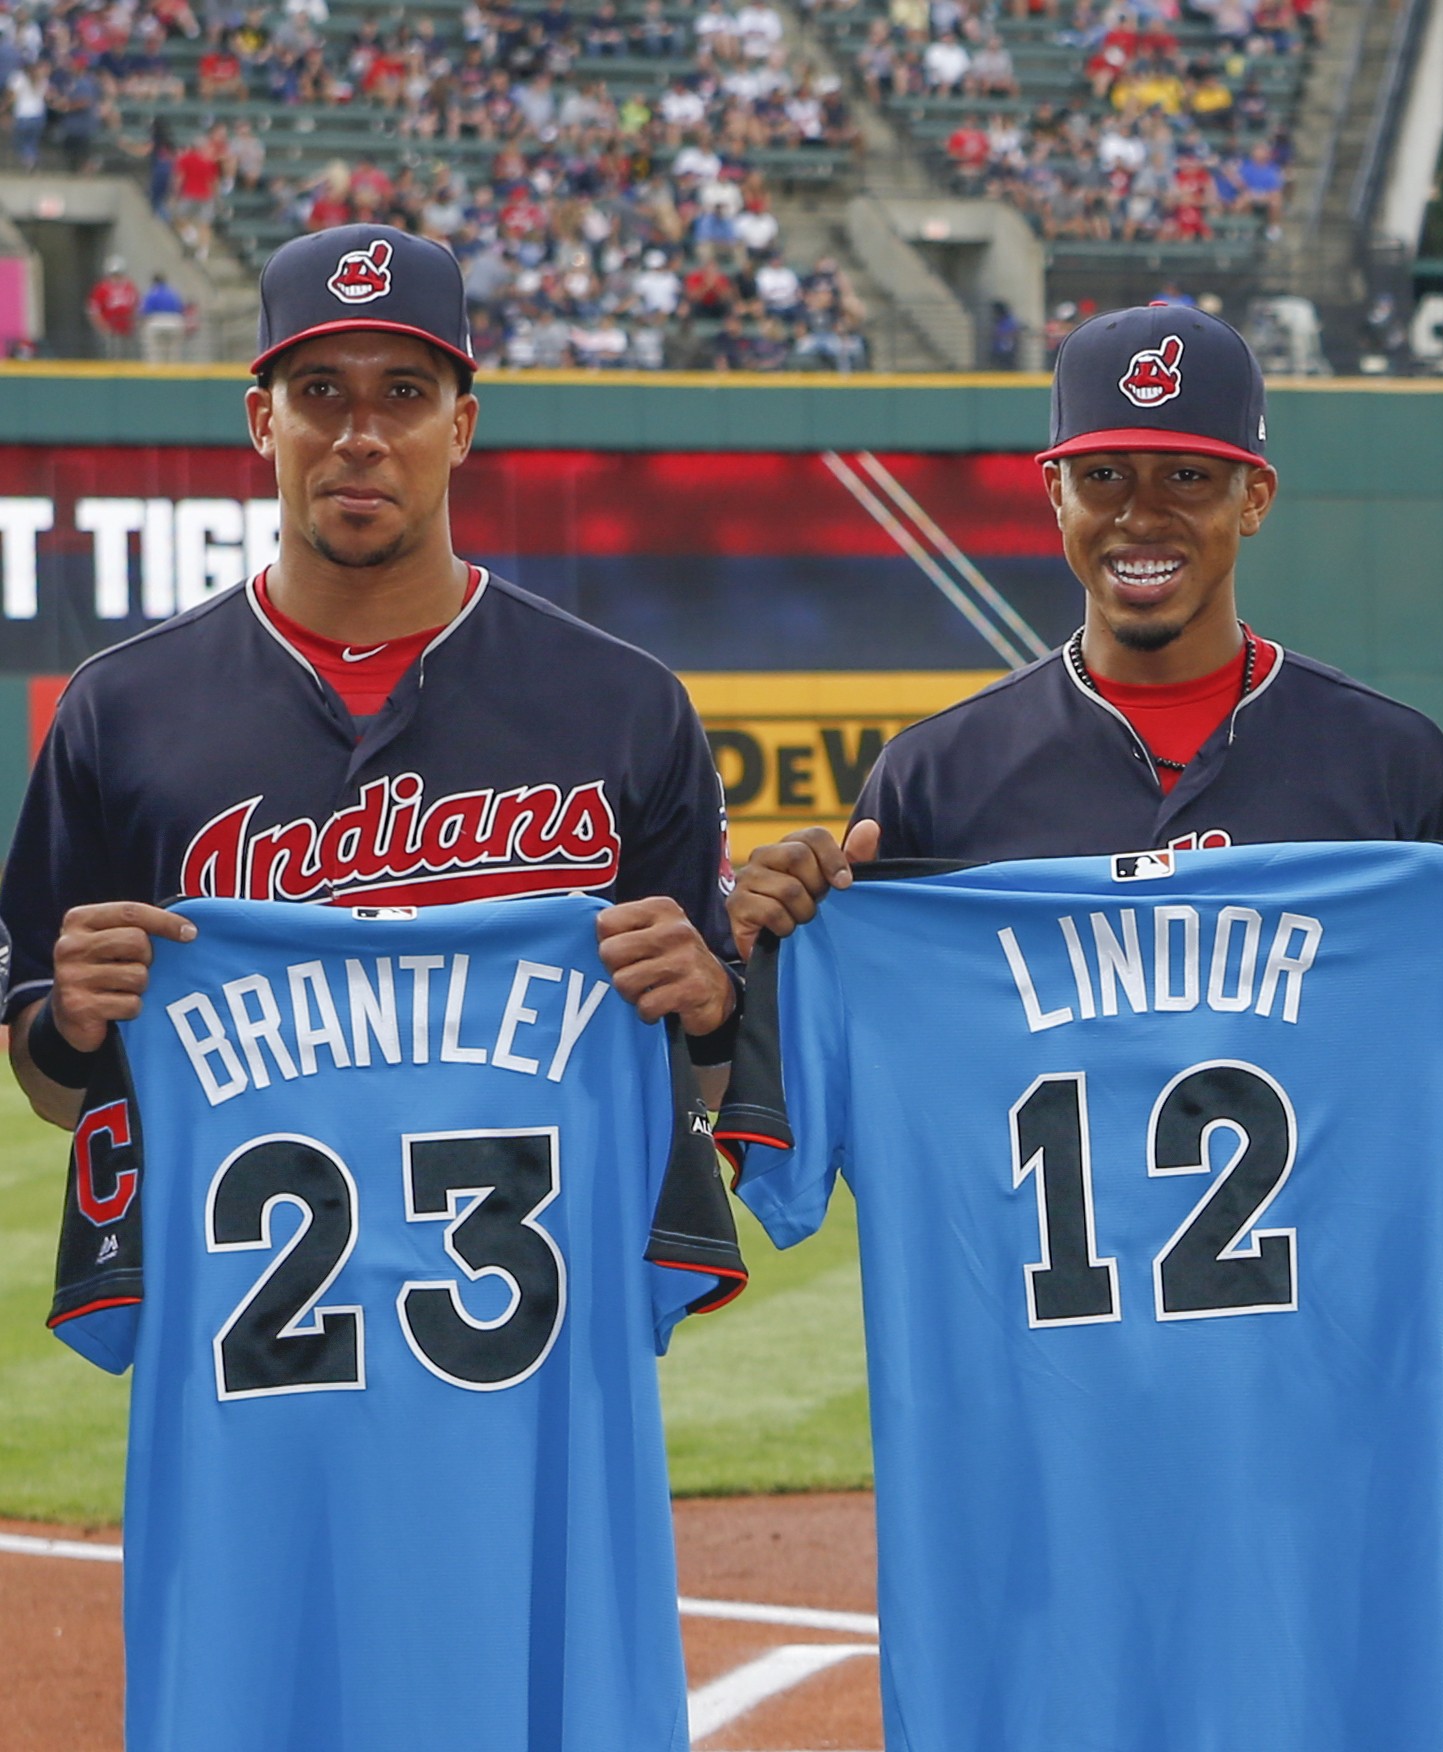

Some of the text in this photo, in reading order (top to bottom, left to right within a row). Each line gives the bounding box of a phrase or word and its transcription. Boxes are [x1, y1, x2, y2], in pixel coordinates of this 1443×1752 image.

[180, 772, 621, 905] Indians
[166, 954, 610, 1106] BRANTLEY
[997, 905, 1323, 1032] LINDOR
[73, 1098, 139, 1226] C
[1008, 1059, 1298, 1329] 12
[205, 1126, 568, 1400] 23
